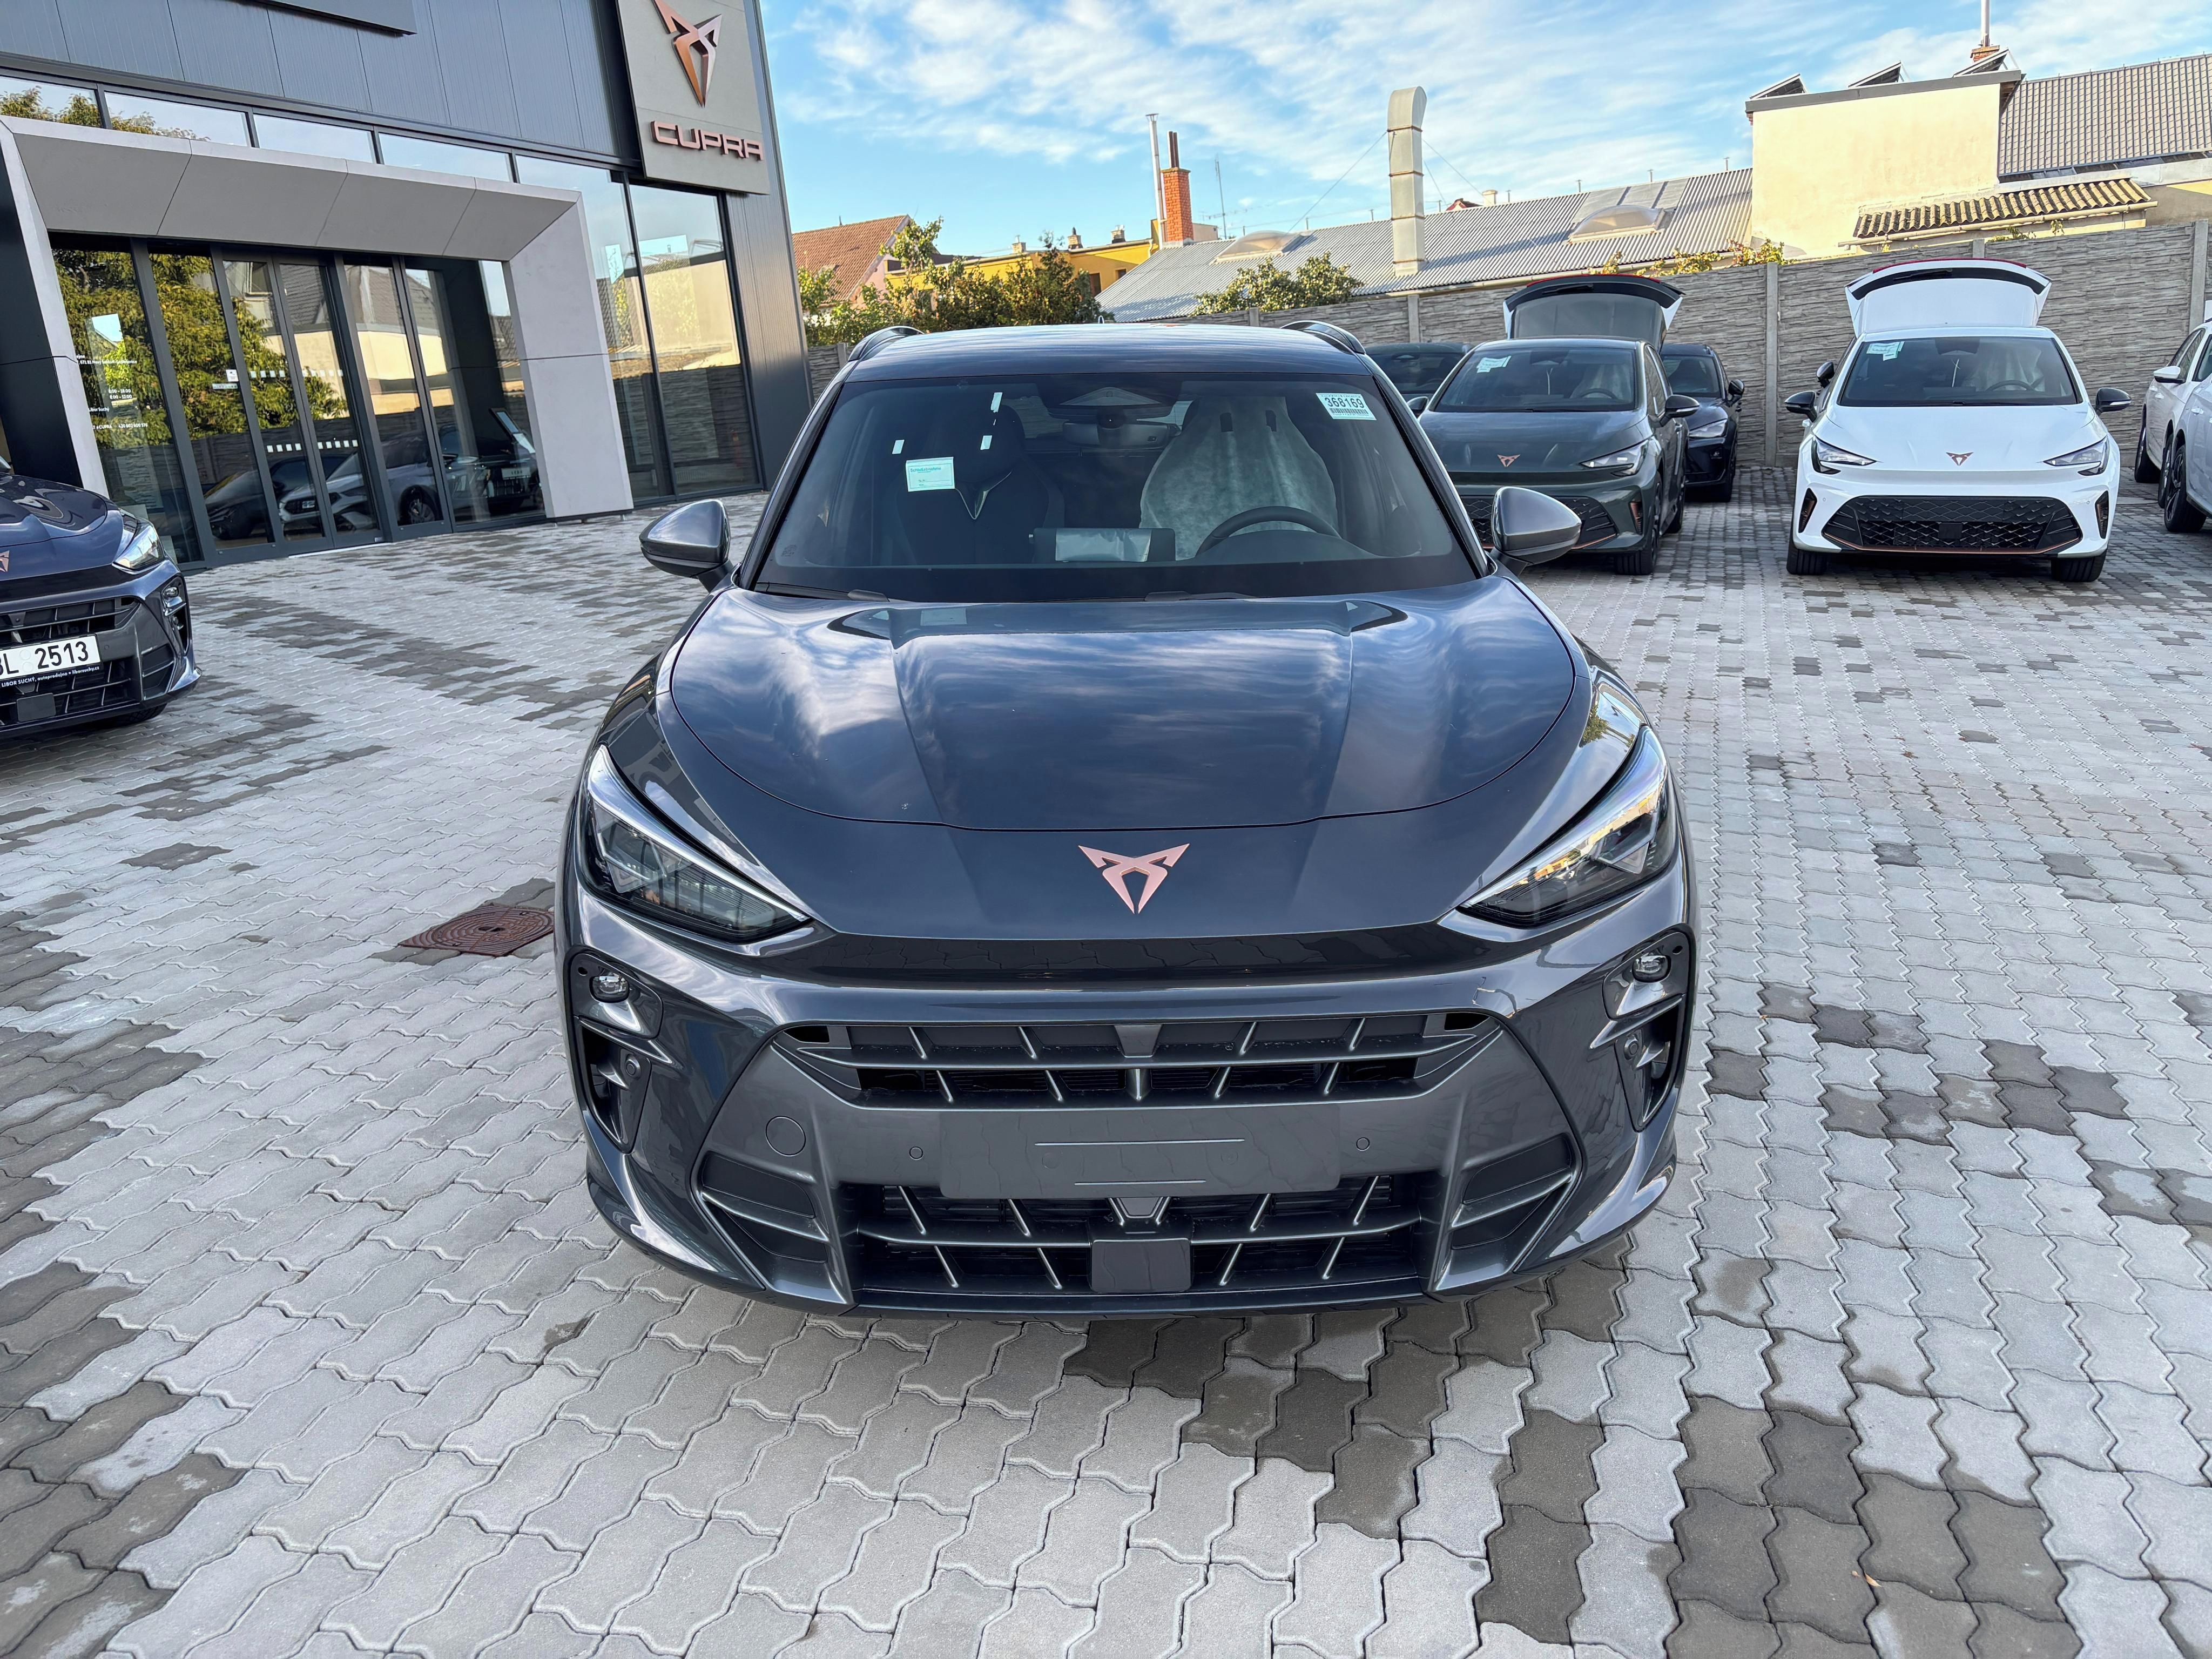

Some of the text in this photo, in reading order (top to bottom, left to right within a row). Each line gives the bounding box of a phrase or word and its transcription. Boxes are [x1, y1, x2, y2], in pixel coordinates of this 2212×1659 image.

[650, 120, 763, 160] CUPRA
[1325, 397, 1364, 408] 368169
[35, 642, 89, 670] 2513
